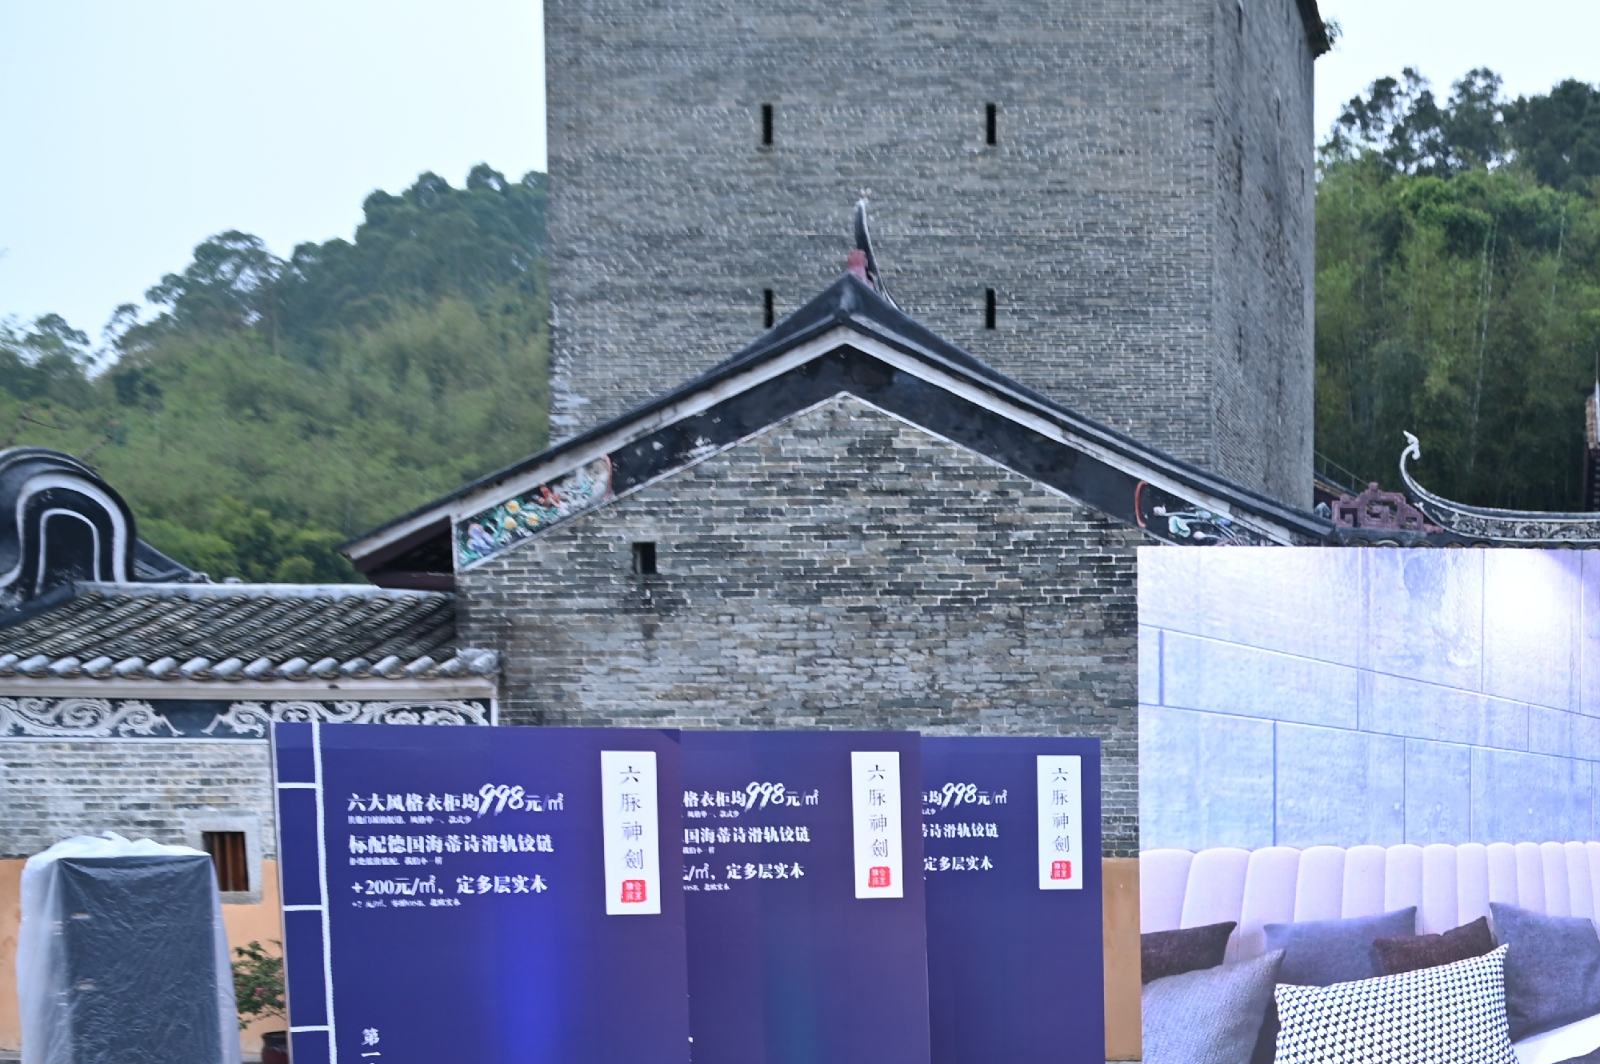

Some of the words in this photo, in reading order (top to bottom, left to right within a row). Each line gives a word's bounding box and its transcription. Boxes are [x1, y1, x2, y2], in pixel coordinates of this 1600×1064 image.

[350, 835, 554, 853] 标配德国海蒂诗滑轨铰链
